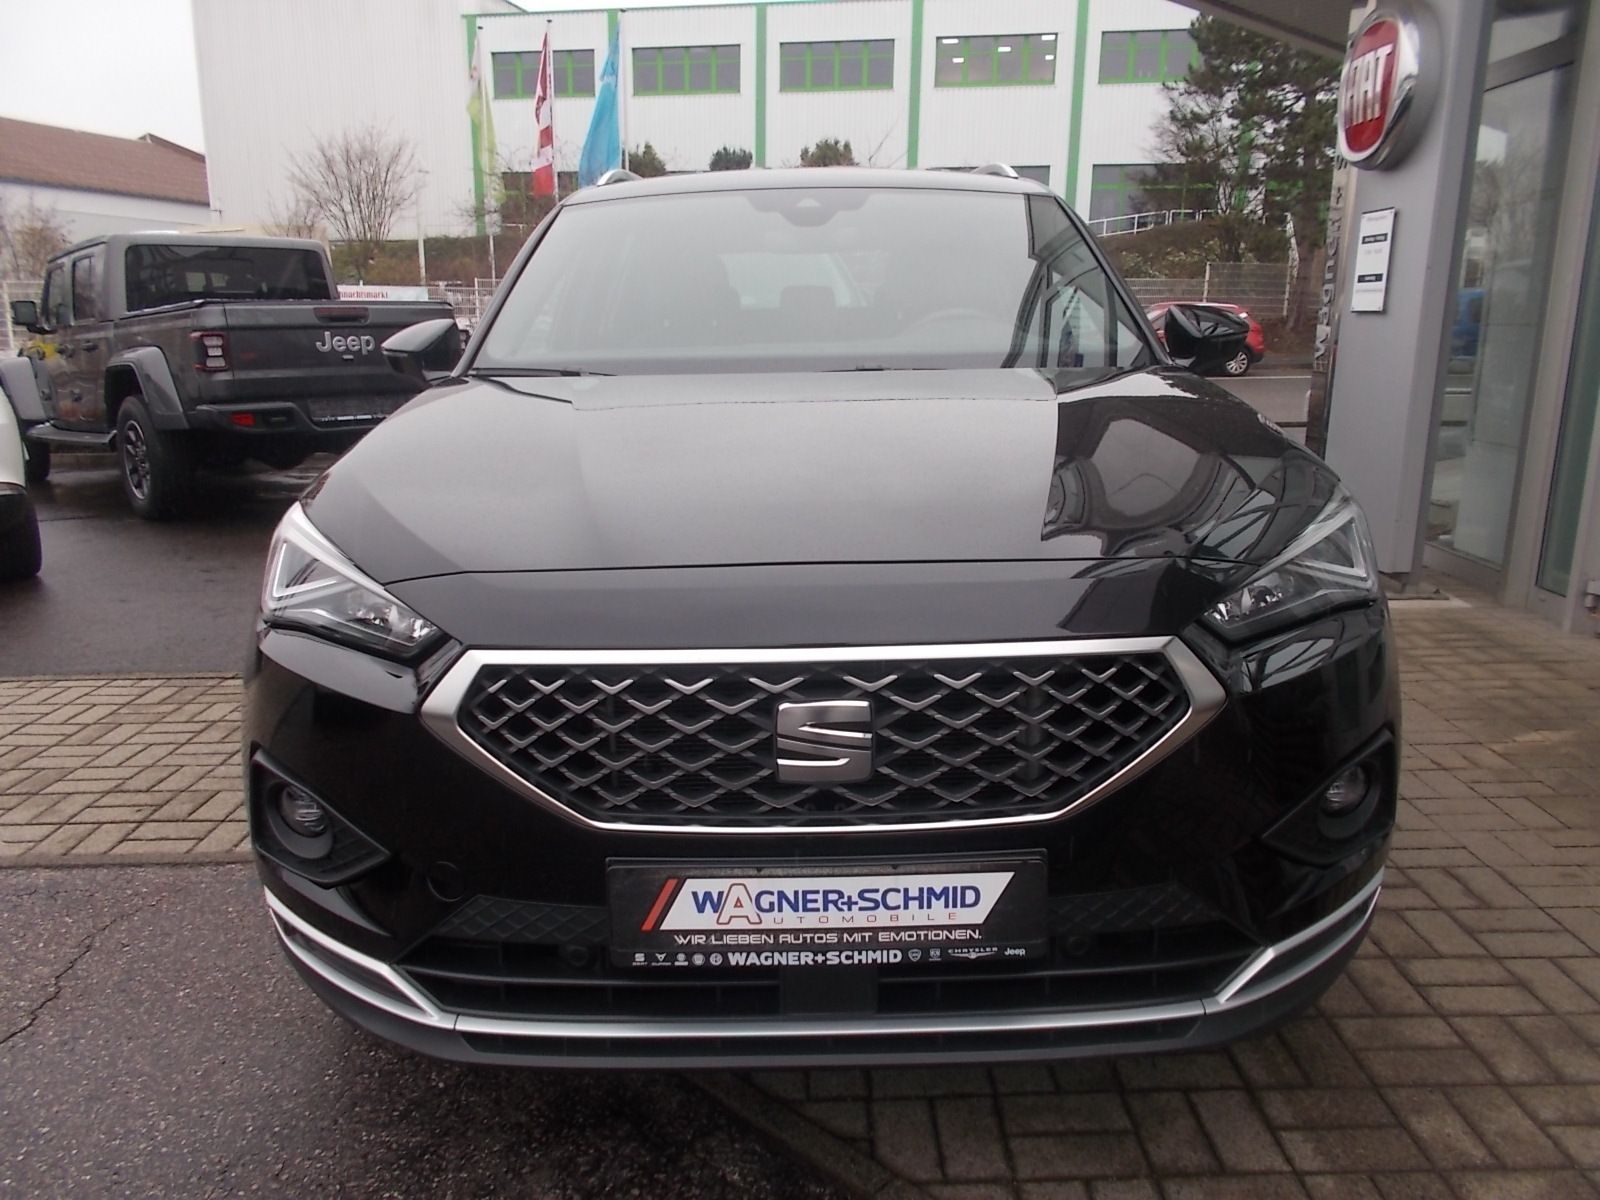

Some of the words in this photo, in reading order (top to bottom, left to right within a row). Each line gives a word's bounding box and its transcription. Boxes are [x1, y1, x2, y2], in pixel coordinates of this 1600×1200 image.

[1343, 43, 1394, 129] FIAT
[315, 331, 376, 355] Jeep
[674, 934, 706, 945] WIR
[711, 933, 774, 945] LIEBEN
[779, 933, 838, 944] AUTOS
[843, 932, 873, 943] MIT
[878, 929, 982, 942] EMOTIONEN.
[728, 950, 903, 966] WAGNER+SCHMID
[1004, 947, 1026, 956] Jeep
